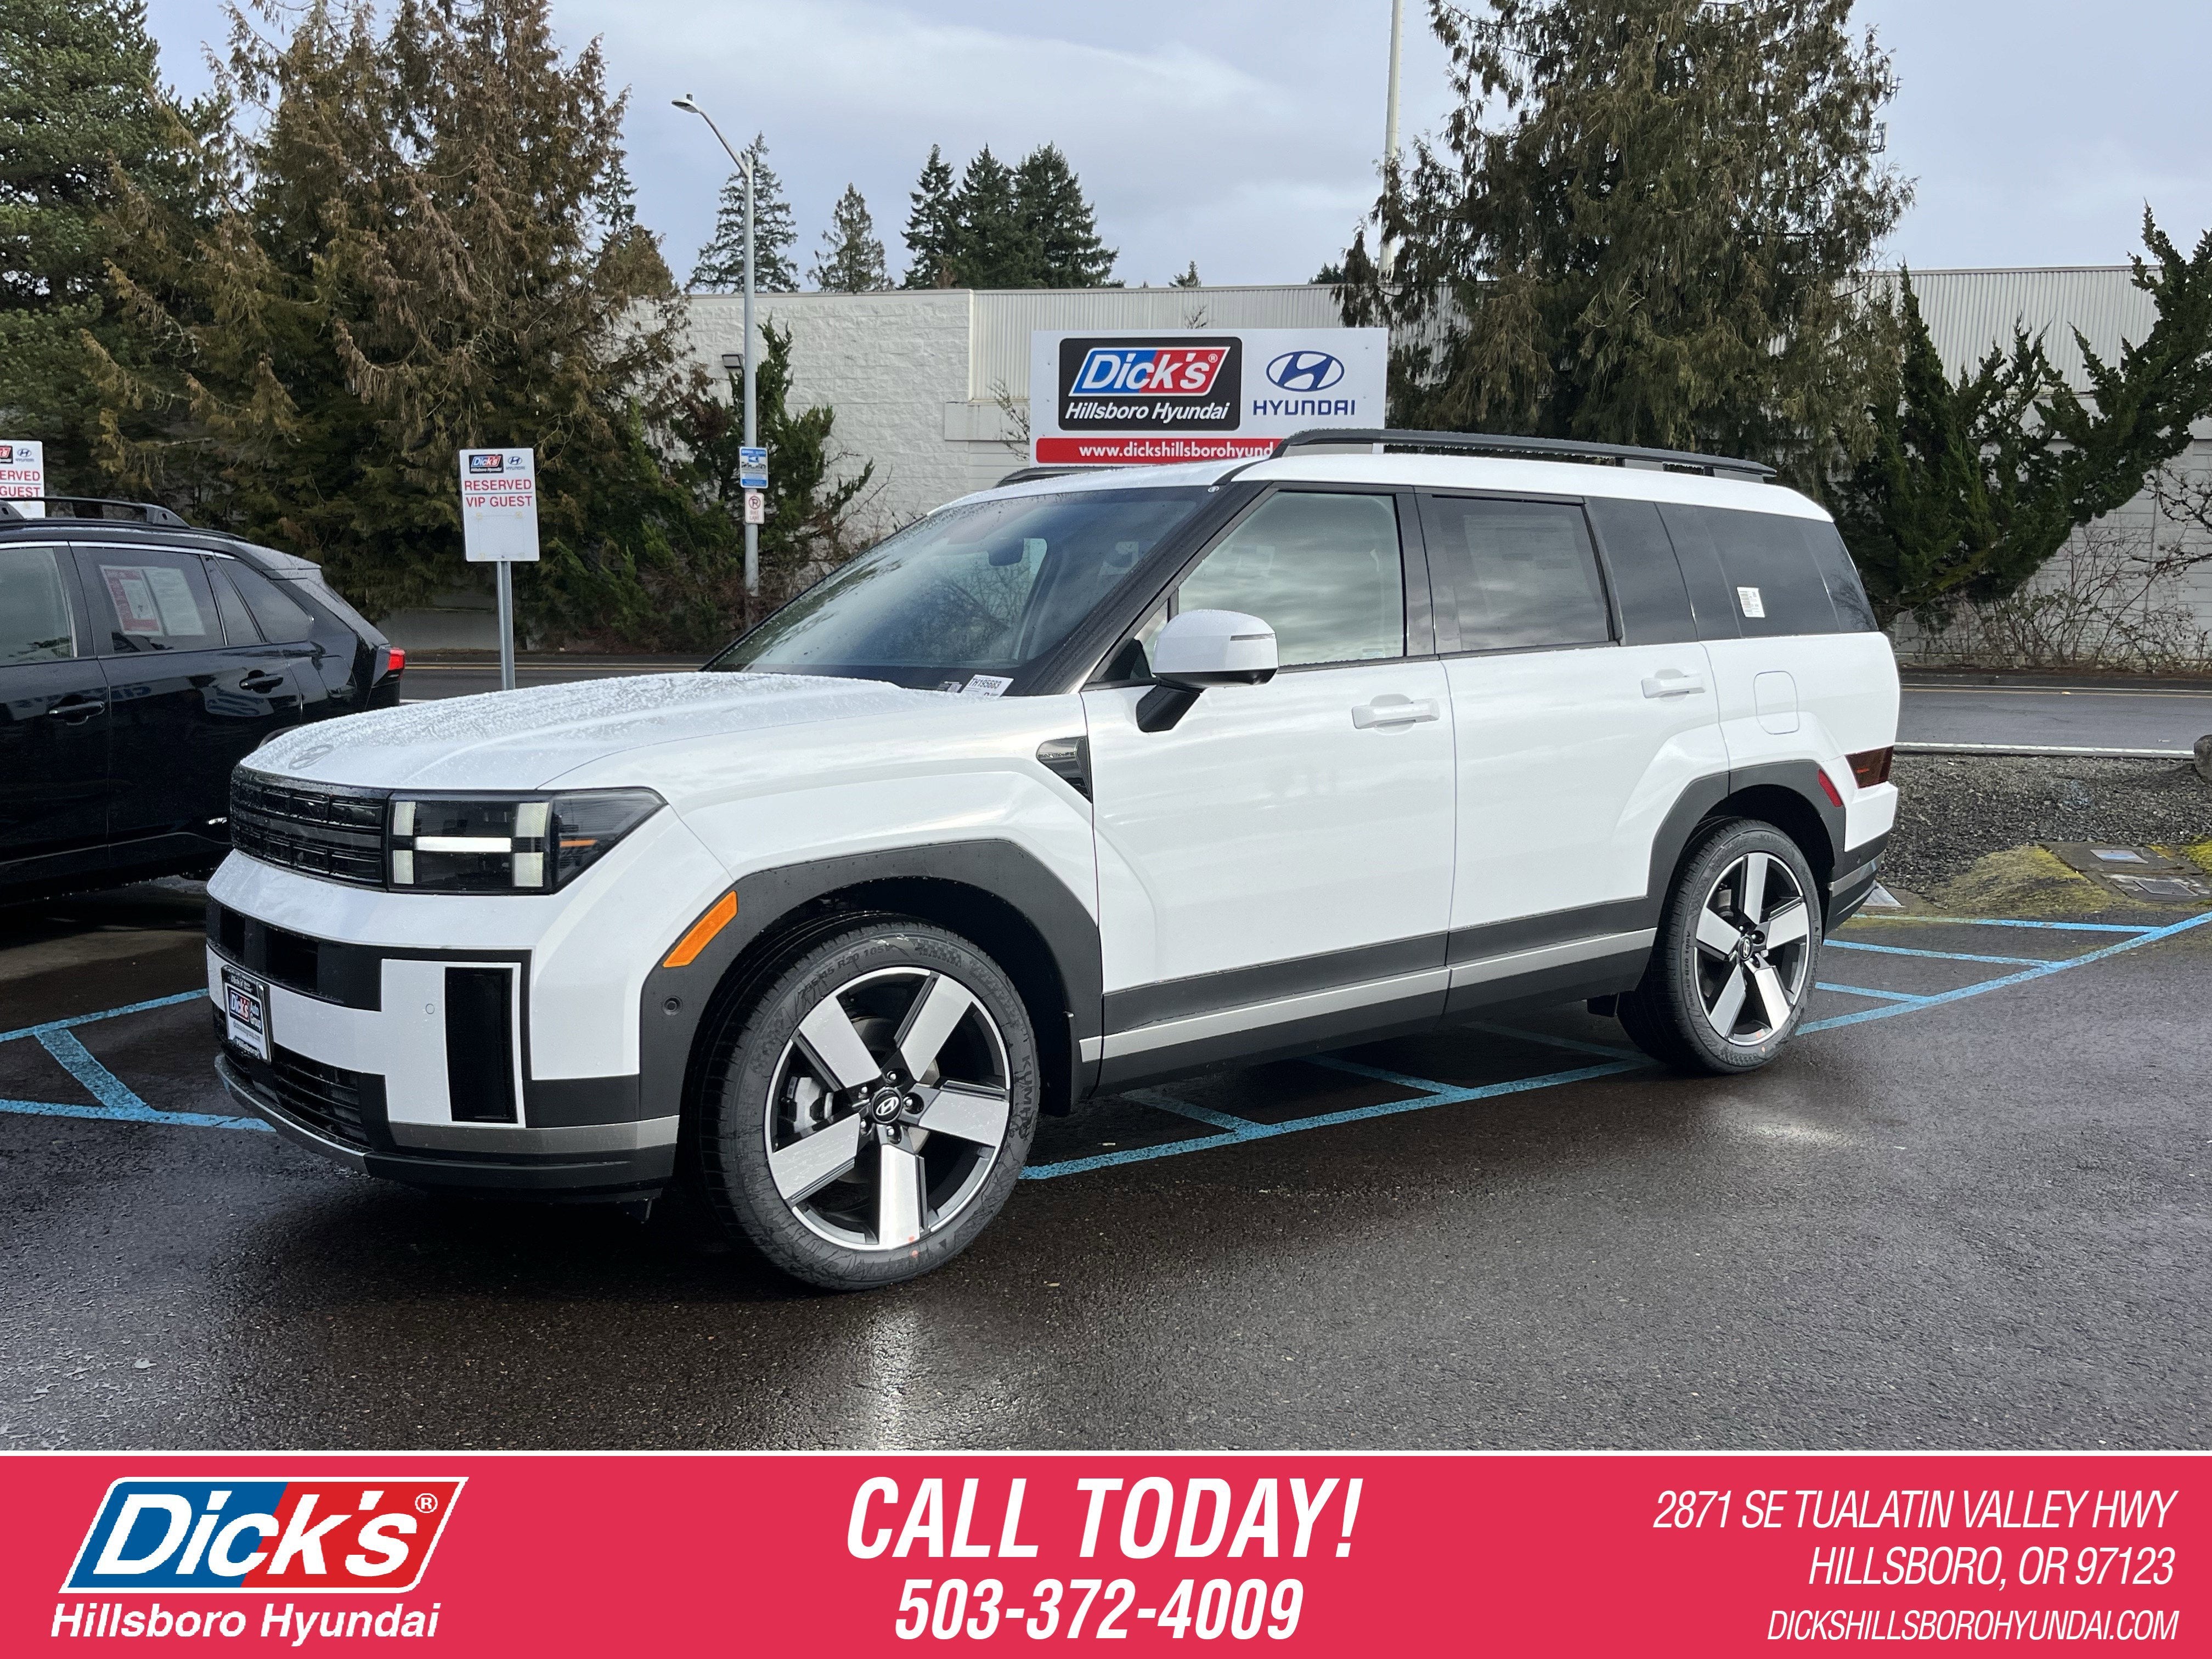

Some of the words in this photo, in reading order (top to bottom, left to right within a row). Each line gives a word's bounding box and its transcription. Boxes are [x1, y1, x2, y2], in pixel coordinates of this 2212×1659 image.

[1081, 353, 1210, 390] Dick's
[1065, 402, 1149, 419] Hillsboro
[1152, 402, 1231, 424] Hyundai
[1253, 400, 1355, 415] HYUNDAI
[1079, 442, 1274, 458] www.dickshillsborohyund
[473, 456, 499, 466] Dick's
[0, 470, 41, 481] ERVED
[464, 479, 532, 491] RESERVED
[466, 496, 486, 507] VIP
[489, 496, 532, 507] GUEST
[231, 994, 249, 1019] Dick's
